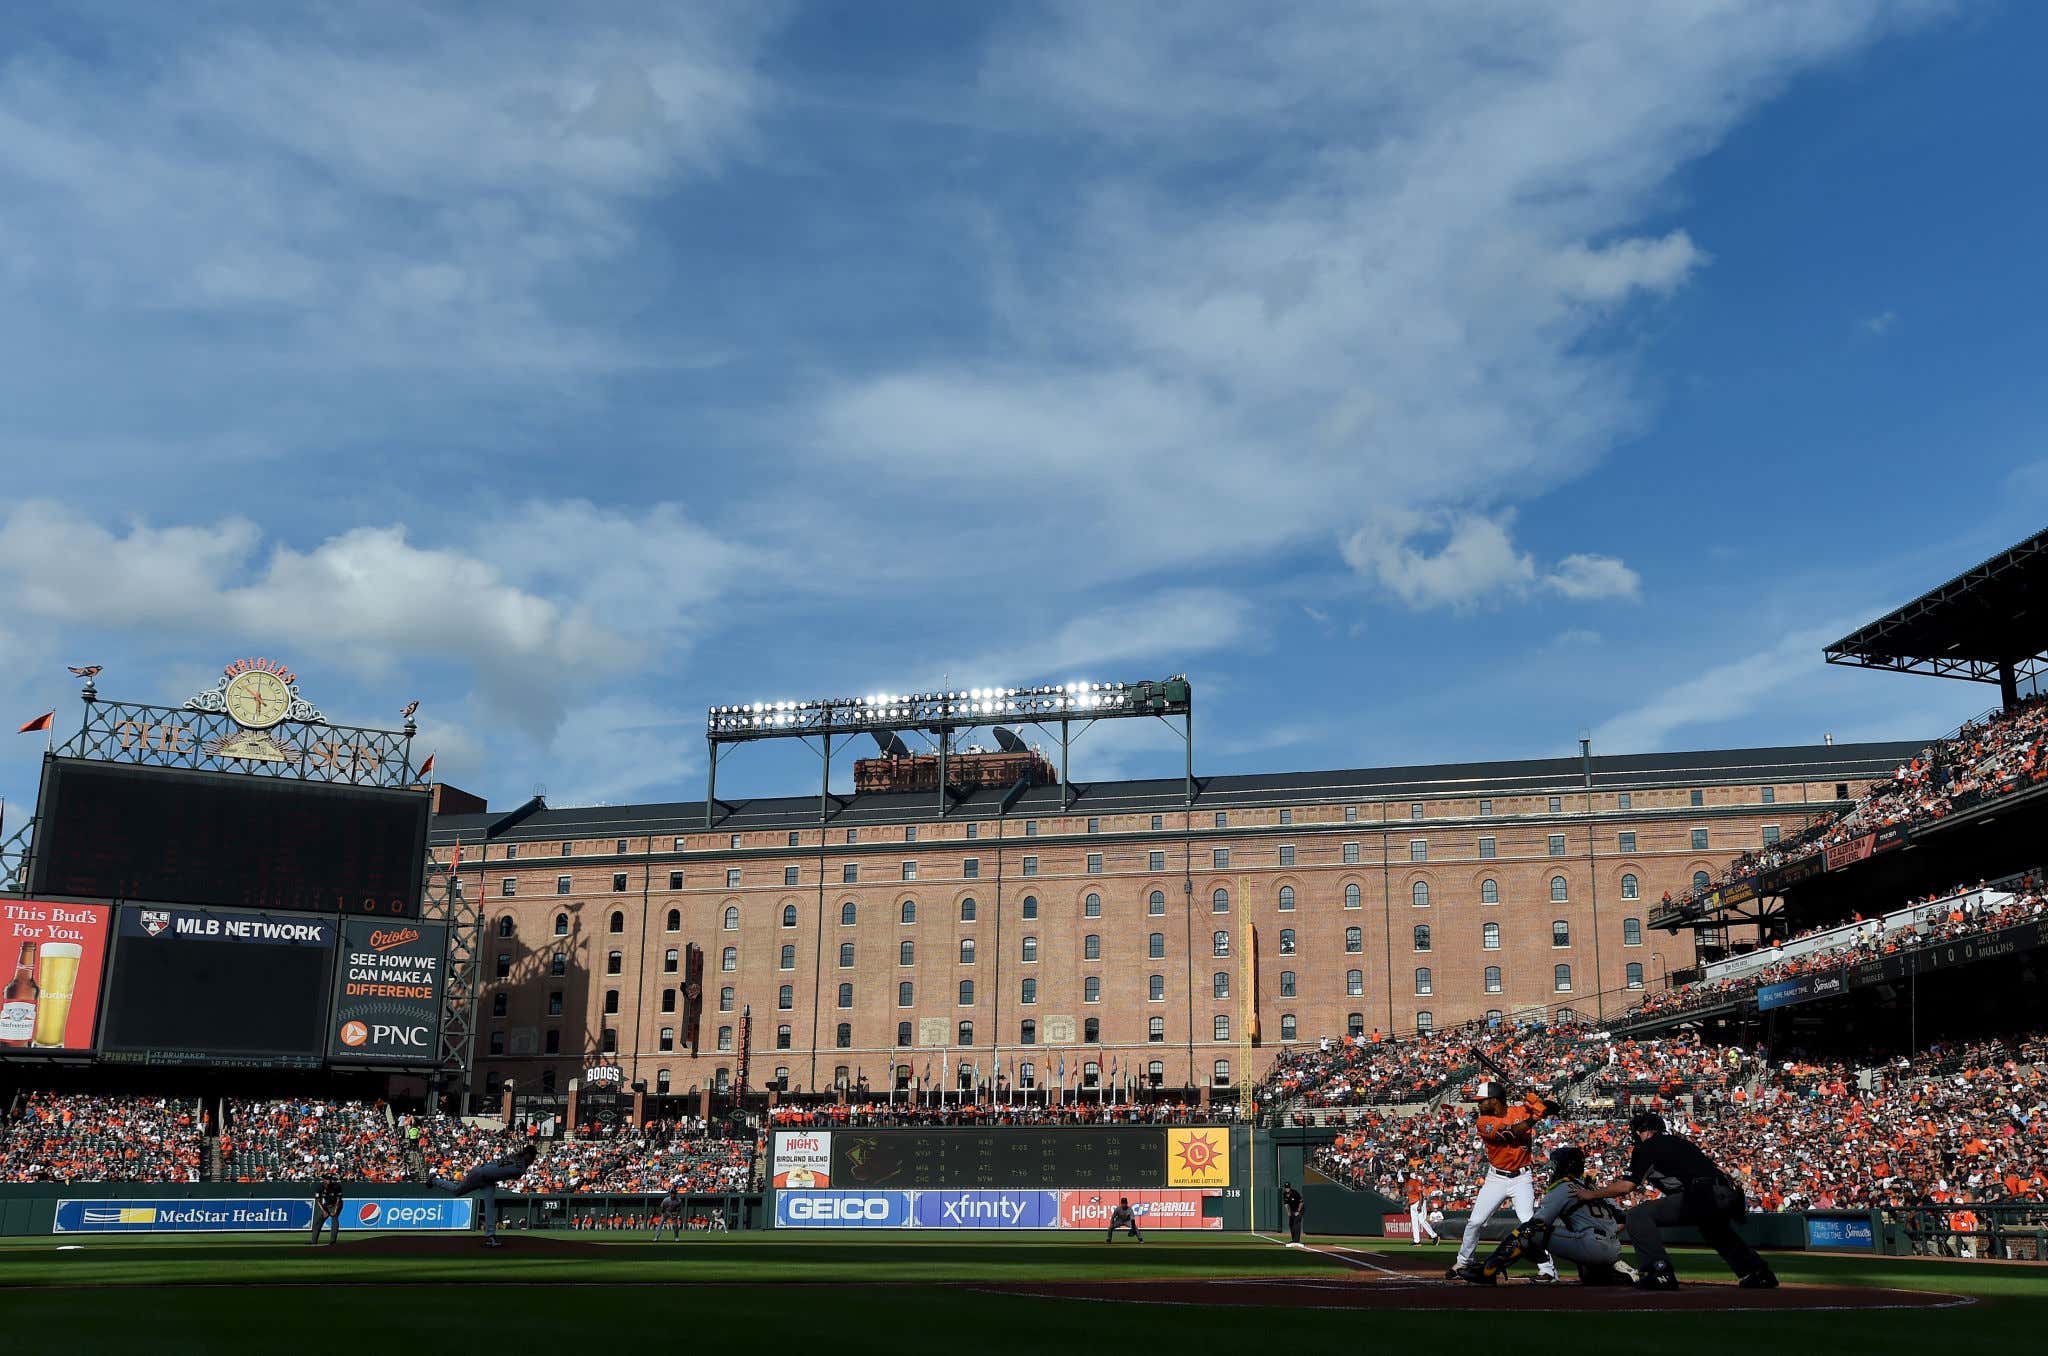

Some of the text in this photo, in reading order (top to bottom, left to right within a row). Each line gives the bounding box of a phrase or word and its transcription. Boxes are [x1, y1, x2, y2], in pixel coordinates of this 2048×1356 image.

[225, 657, 296, 685] ORIOLES
[116, 720, 383, 773] THE SUN
[4, 905, 97, 924] This Bud's
[143, 912, 169, 920] MLB
[12, 923, 84, 940] For You.
[176, 918, 322, 942] MLB NETWORK
[370, 928, 419, 950] Orioles
[1979, 942, 2015, 959] MULLINS
[350, 953, 436, 969] SEE HOW WE
[349, 968, 433, 984] CAN MAKE A
[346, 983, 433, 999] DIFFERENCE
[371, 1024, 429, 1046] PNC
[786, 1138, 819, 1151] HIGH'S
[1225, 1189, 1240, 1198] 318
[544, 1201, 558, 1210] 373
[788, 1198, 890, 1220] GEICO
[943, 1194, 1028, 1224] xfinity
[1150, 1201, 1196, 1212] CARROLL
[159, 1207, 288, 1223] MedStar Health
[386, 1205, 443, 1224] pepsi
[1385, 1218, 1398, 1233] weis
